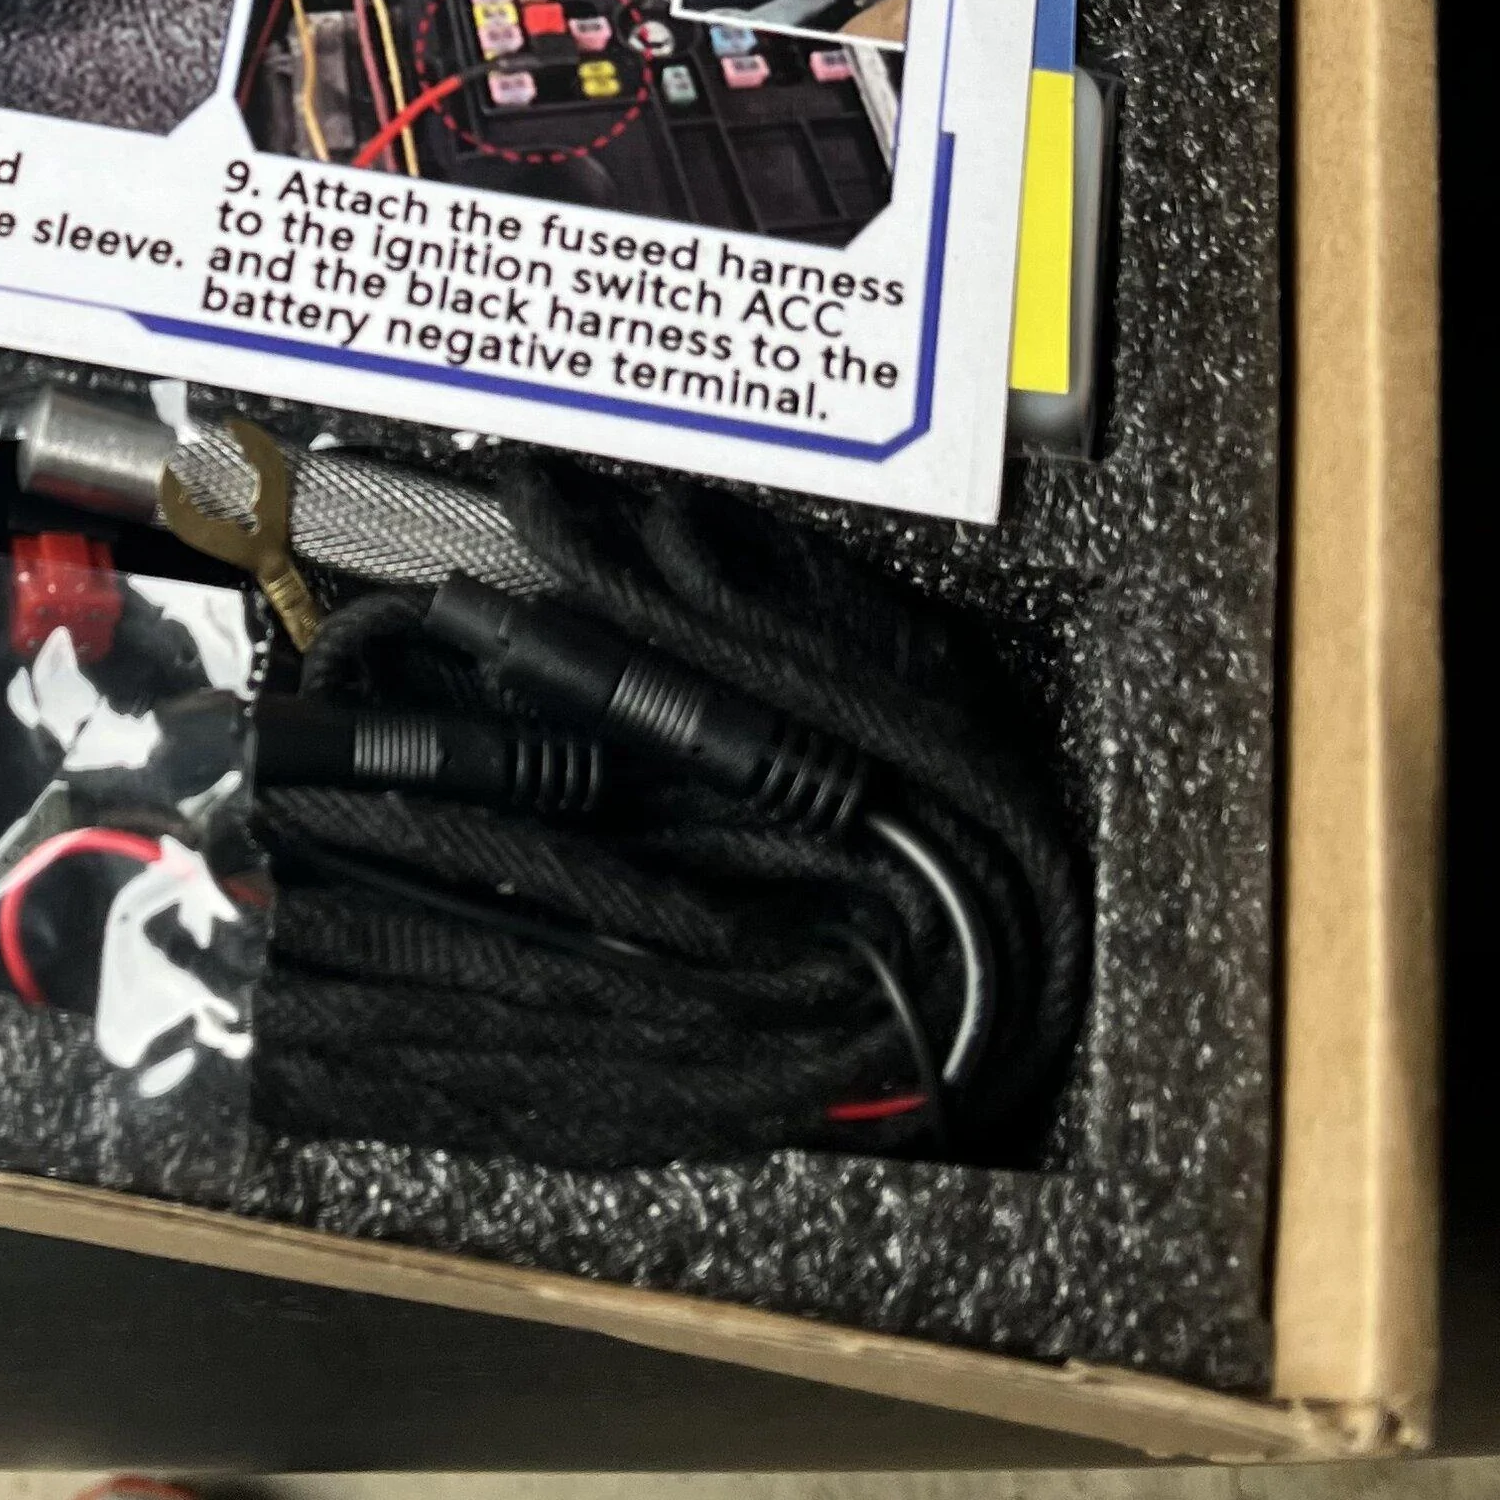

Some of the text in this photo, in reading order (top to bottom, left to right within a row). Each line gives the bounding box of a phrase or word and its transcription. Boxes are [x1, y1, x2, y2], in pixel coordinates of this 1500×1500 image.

[33, 212, 183, 269] sleeve.
[218, 200, 845, 339] to the ignition switch ACC
[225, 159, 904, 307] 9. Attach the fuseed harness
[200, 275, 828, 422] battery negative terminal.
[207, 246, 899, 390] and the black harness to the
